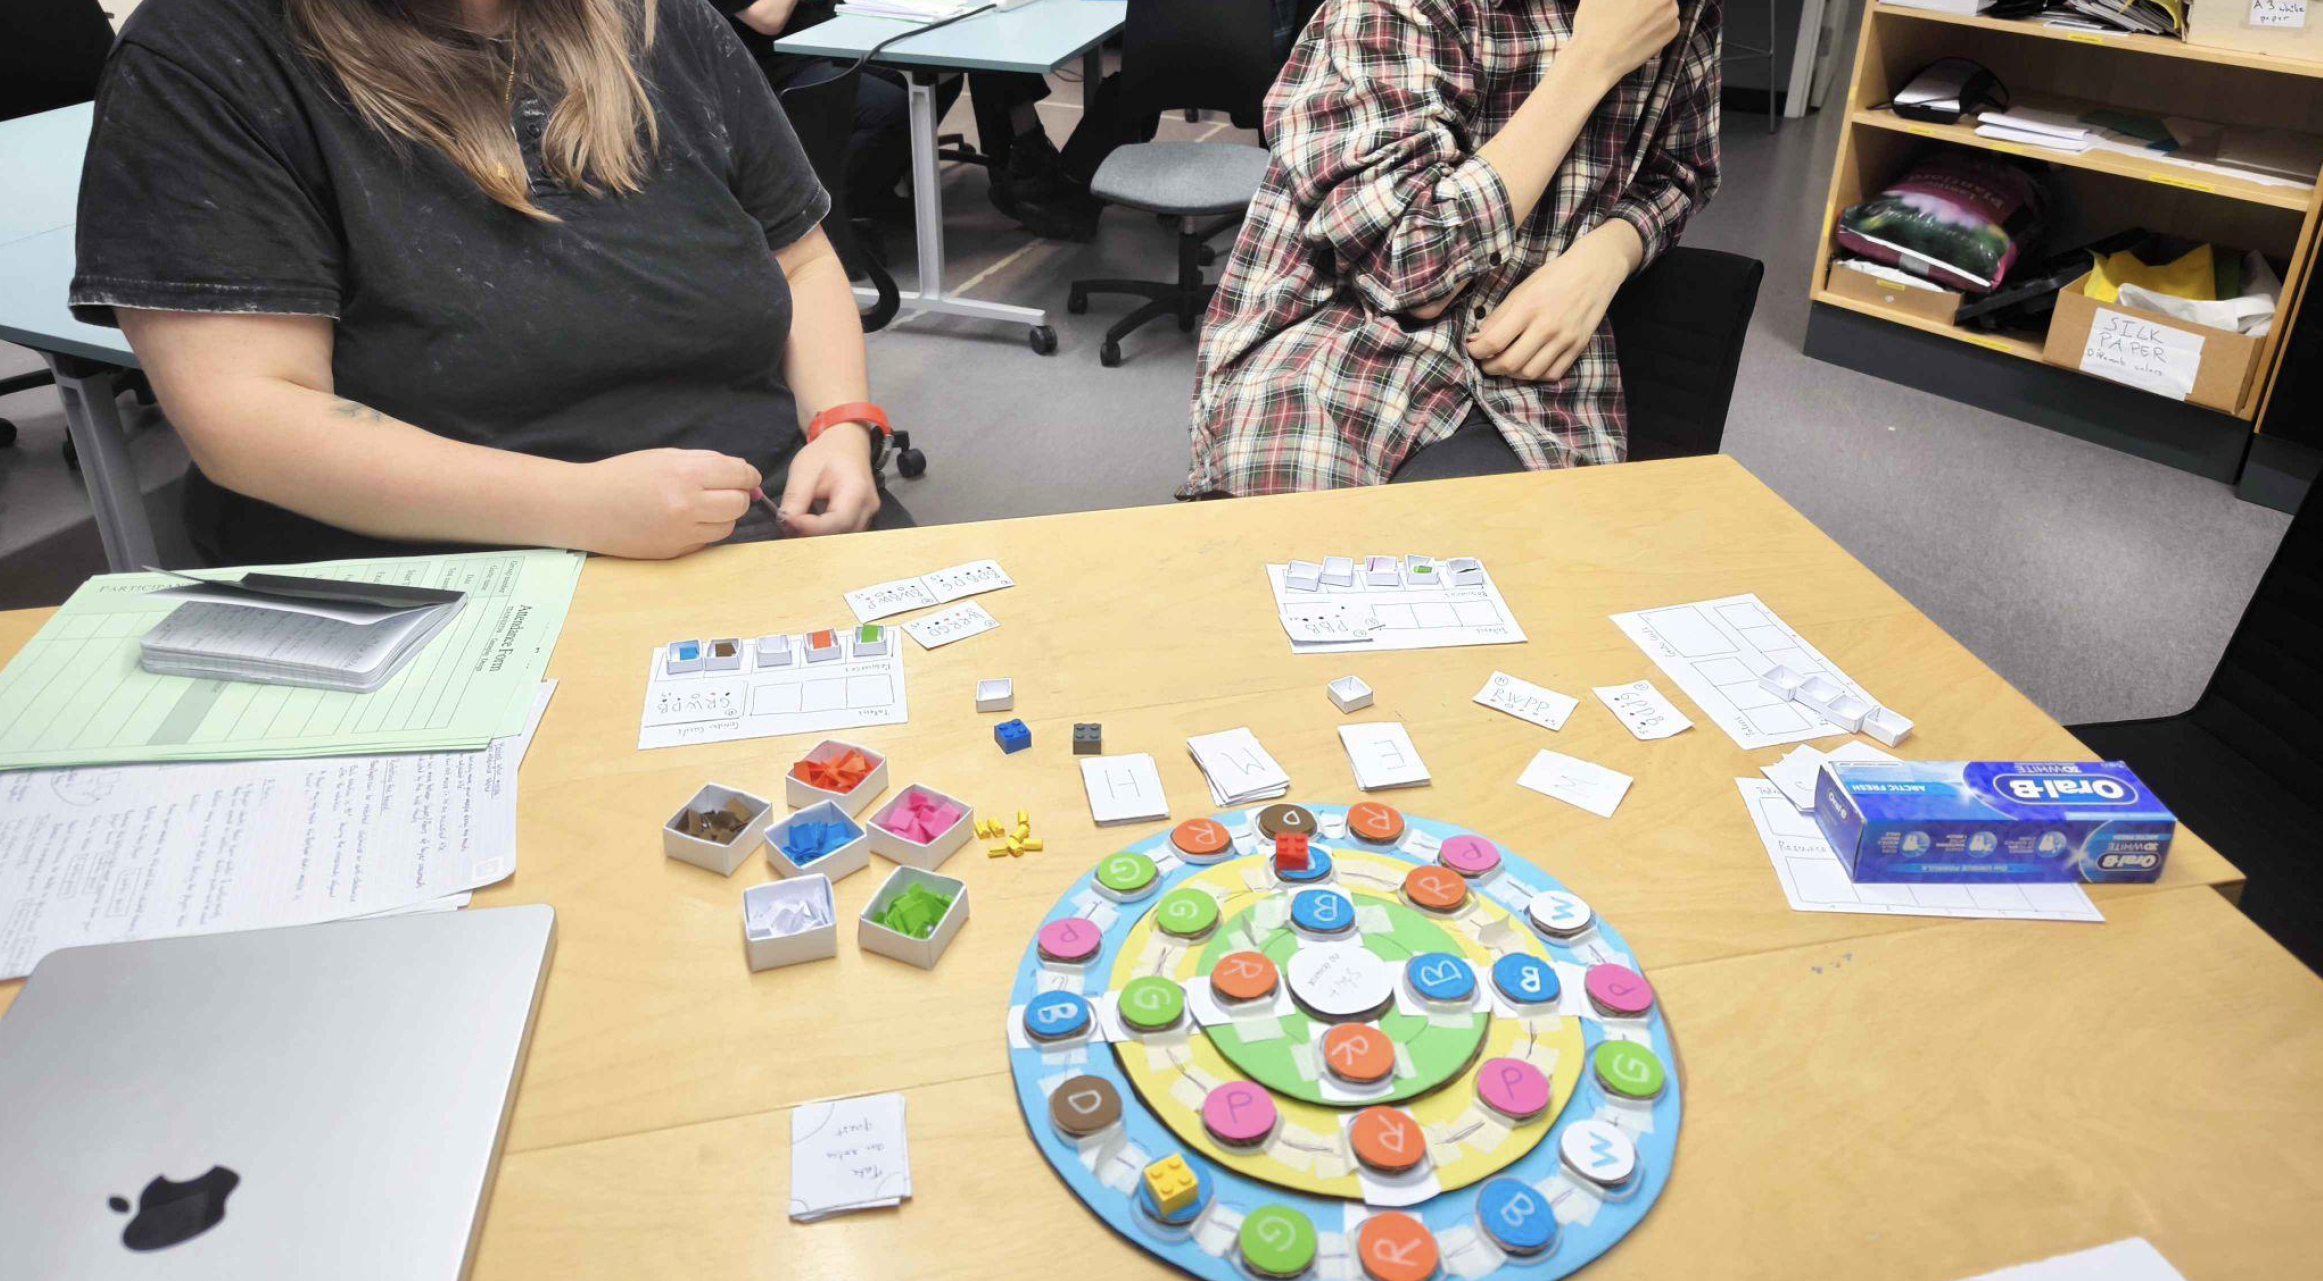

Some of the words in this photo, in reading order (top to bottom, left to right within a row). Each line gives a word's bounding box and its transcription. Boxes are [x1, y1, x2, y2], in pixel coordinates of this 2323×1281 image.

[2103, 317, 2164, 344] SILK
[2099, 331, 2167, 363] PAPER
[501, 604, 533, 647] Attendance
[490, 648, 513, 672] Form
[1373, 739, 1407, 771] E
[1104, 769, 1141, 801] H
[2009, 779, 2124, 799] Oral-B
[1283, 810, 1301, 826] D
[1361, 807, 1389, 830] R
[1189, 824, 1216, 843] R
[1462, 844, 1482, 860] P
[2100, 853, 2157, 869] Oral-B
[1111, 858, 1140, 883] G
[1421, 878, 1456, 901] R
[1169, 900, 1199, 919] G
[1314, 894, 1336, 921] B
[1064, 924, 1080, 942] P
[1222, 960, 1262, 980] R
[1421, 961, 1461, 986] B
[1521, 966, 1541, 992] B
[1134, 985, 1171, 1009] G
[1608, 980, 1637, 997] P
[1038, 1003, 1078, 1022] B
[1332, 1037, 1368, 1065] R
[1612, 1053, 1649, 1082] G
[1501, 1068, 1523, 1100] P
[1068, 1090, 1101, 1114] D
[1227, 1091, 1252, 1123] P
[1380, 1116, 1403, 1152] R
[1501, 1194, 1536, 1227] B
[1256, 1215, 1297, 1251] G
[1374, 1236, 1422, 1265] R
